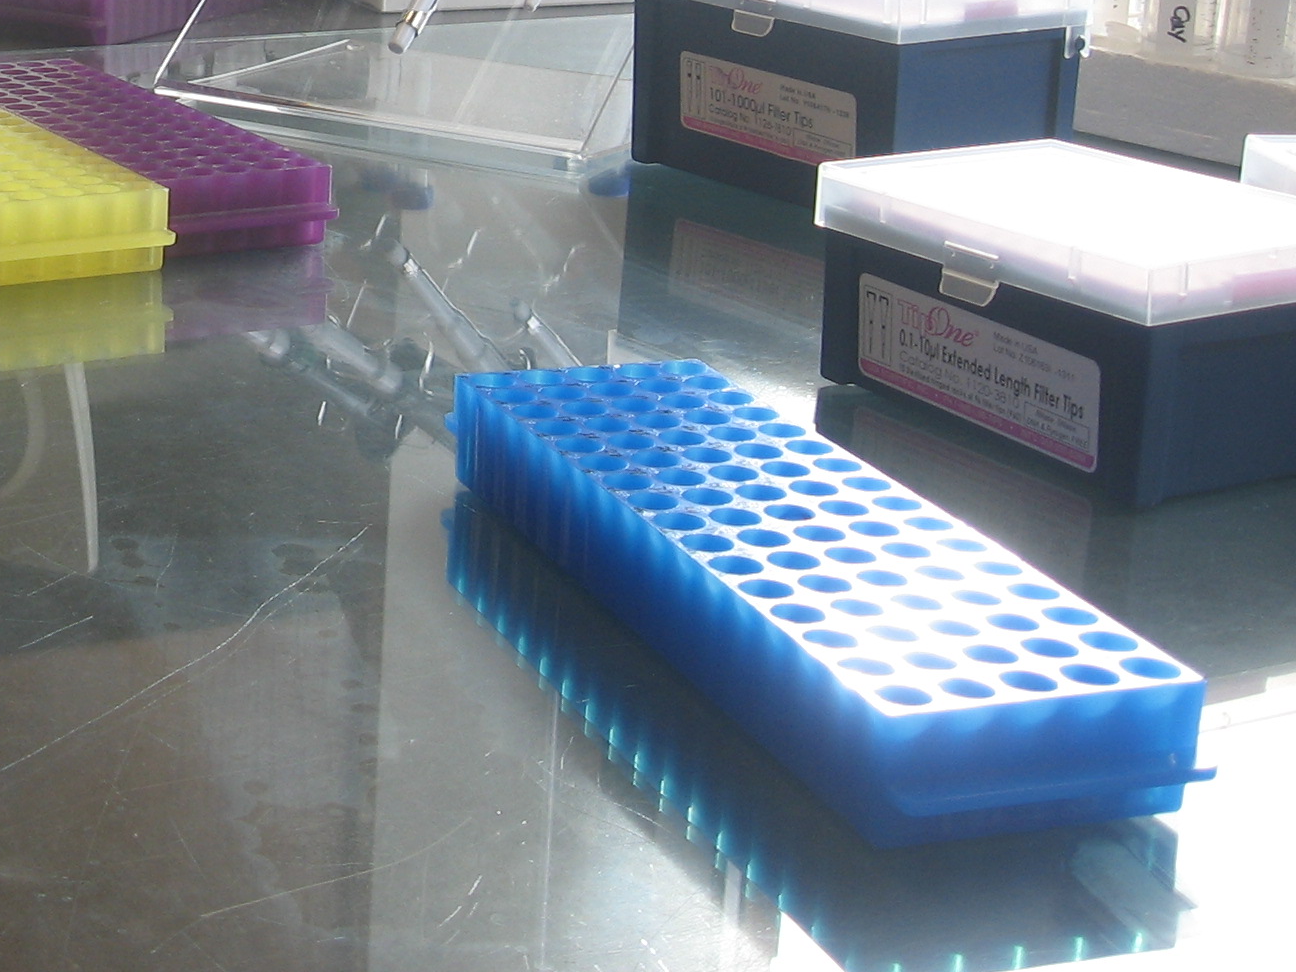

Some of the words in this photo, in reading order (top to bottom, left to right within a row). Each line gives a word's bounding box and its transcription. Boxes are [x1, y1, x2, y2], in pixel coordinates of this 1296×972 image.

[899, 350, 942, 379] Catalog
[942, 345, 991, 380] Extended
[994, 366, 1031, 397] Length
[1034, 382, 1060, 408] Filter
[1063, 393, 1084, 419] Tips
